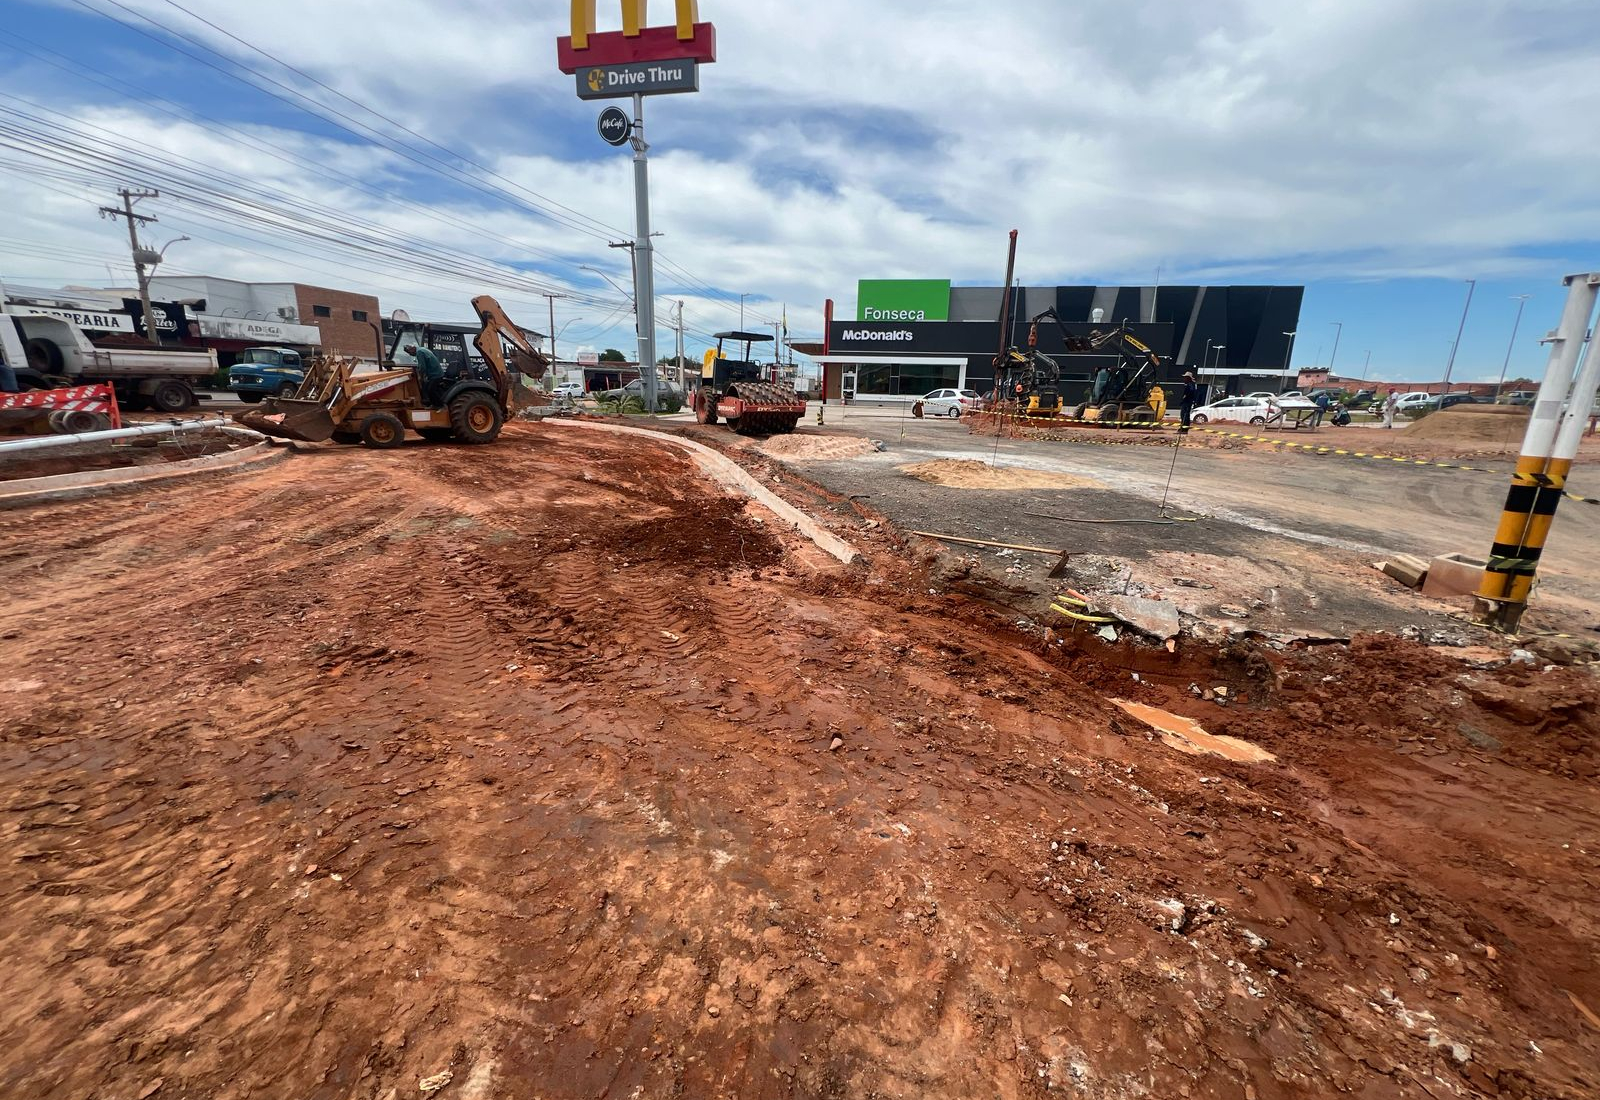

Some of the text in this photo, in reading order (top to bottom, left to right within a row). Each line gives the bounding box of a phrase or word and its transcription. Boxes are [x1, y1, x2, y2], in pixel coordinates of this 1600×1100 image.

[608, 66, 682, 86] Drive Thru
[864, 307, 925, 320] Fonseca
[247, 324, 283, 334] ADEGA
[842, 329, 913, 341] McDonald's
